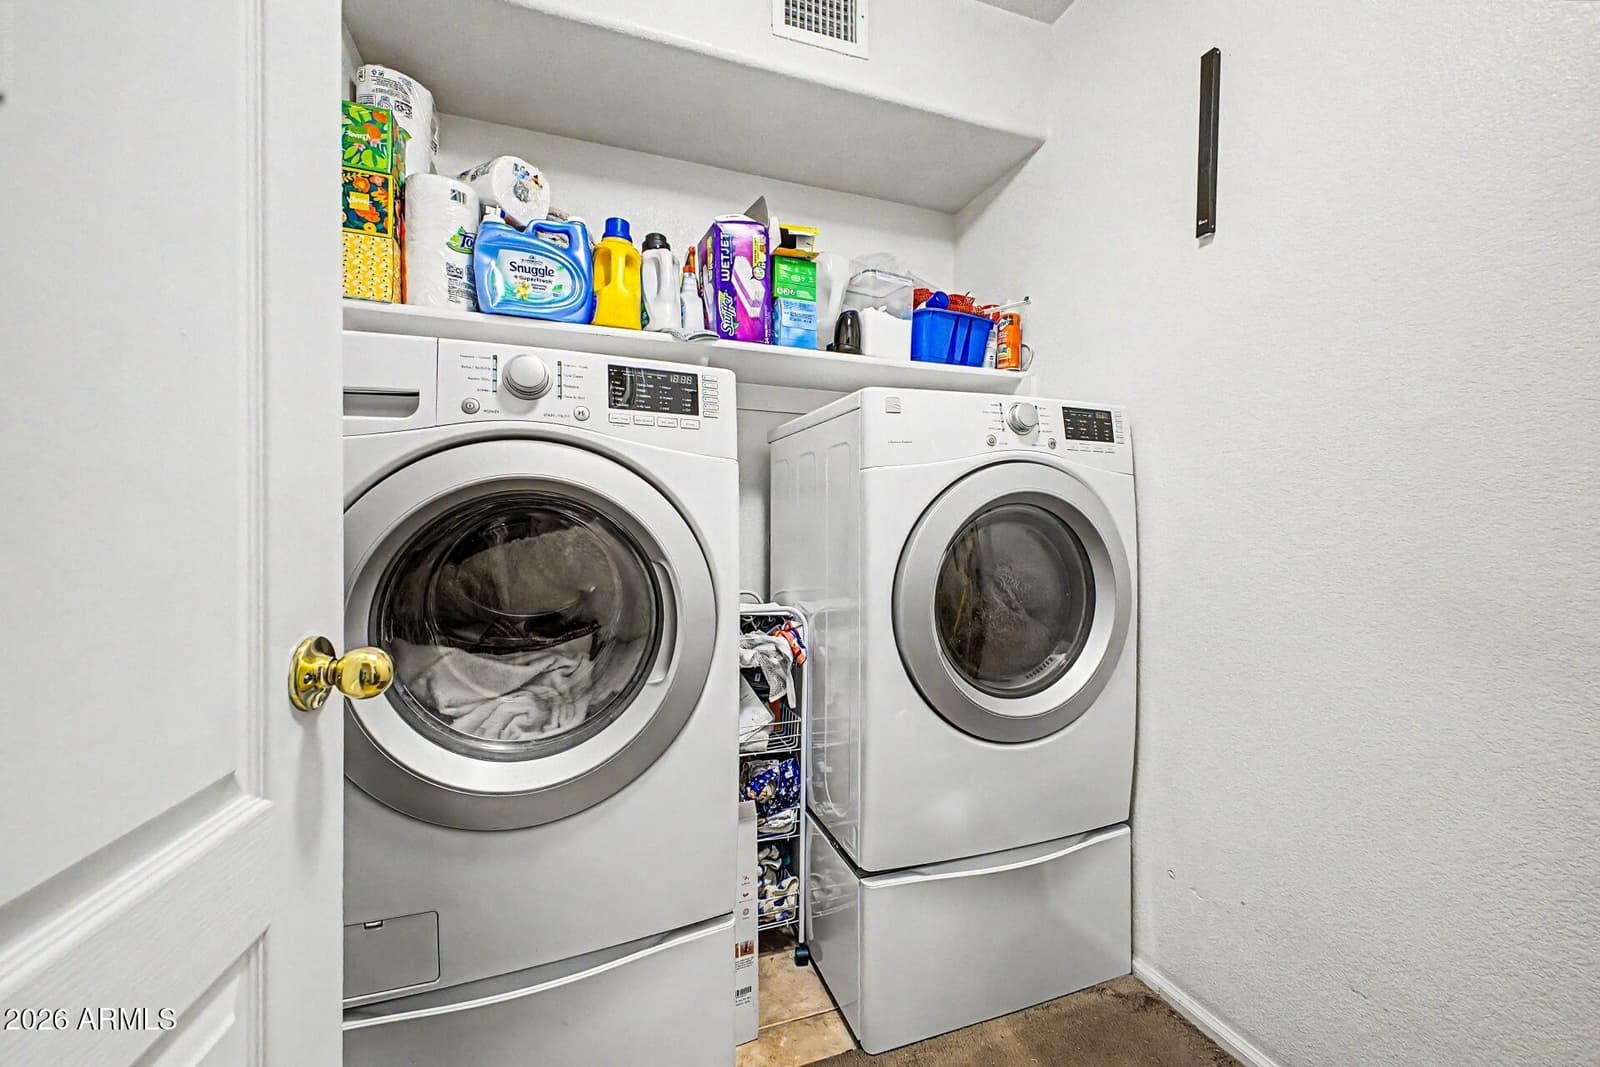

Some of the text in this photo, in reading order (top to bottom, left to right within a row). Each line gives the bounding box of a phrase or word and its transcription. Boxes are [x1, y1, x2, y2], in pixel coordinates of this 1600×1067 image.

[509, 260, 555, 277] Snuggle
[720, 232, 731, 282] WETJET
[720, 291, 736, 337] Swiffer
